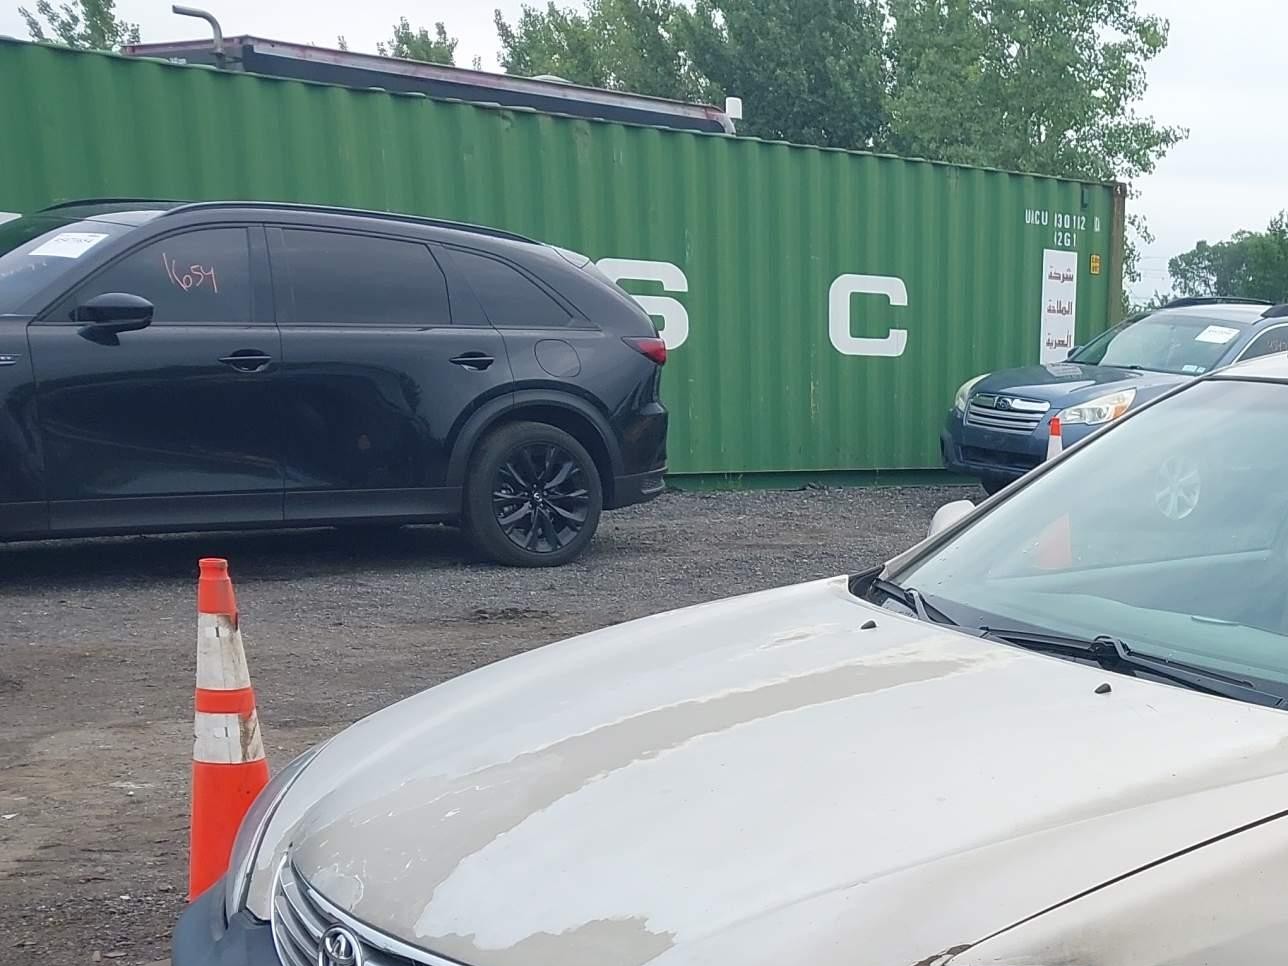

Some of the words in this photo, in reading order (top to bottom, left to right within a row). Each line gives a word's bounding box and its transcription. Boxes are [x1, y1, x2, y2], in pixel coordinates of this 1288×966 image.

[162, 252, 218, 294] 1654
[595, 258, 689, 350] S
[828, 273, 908, 357] C
